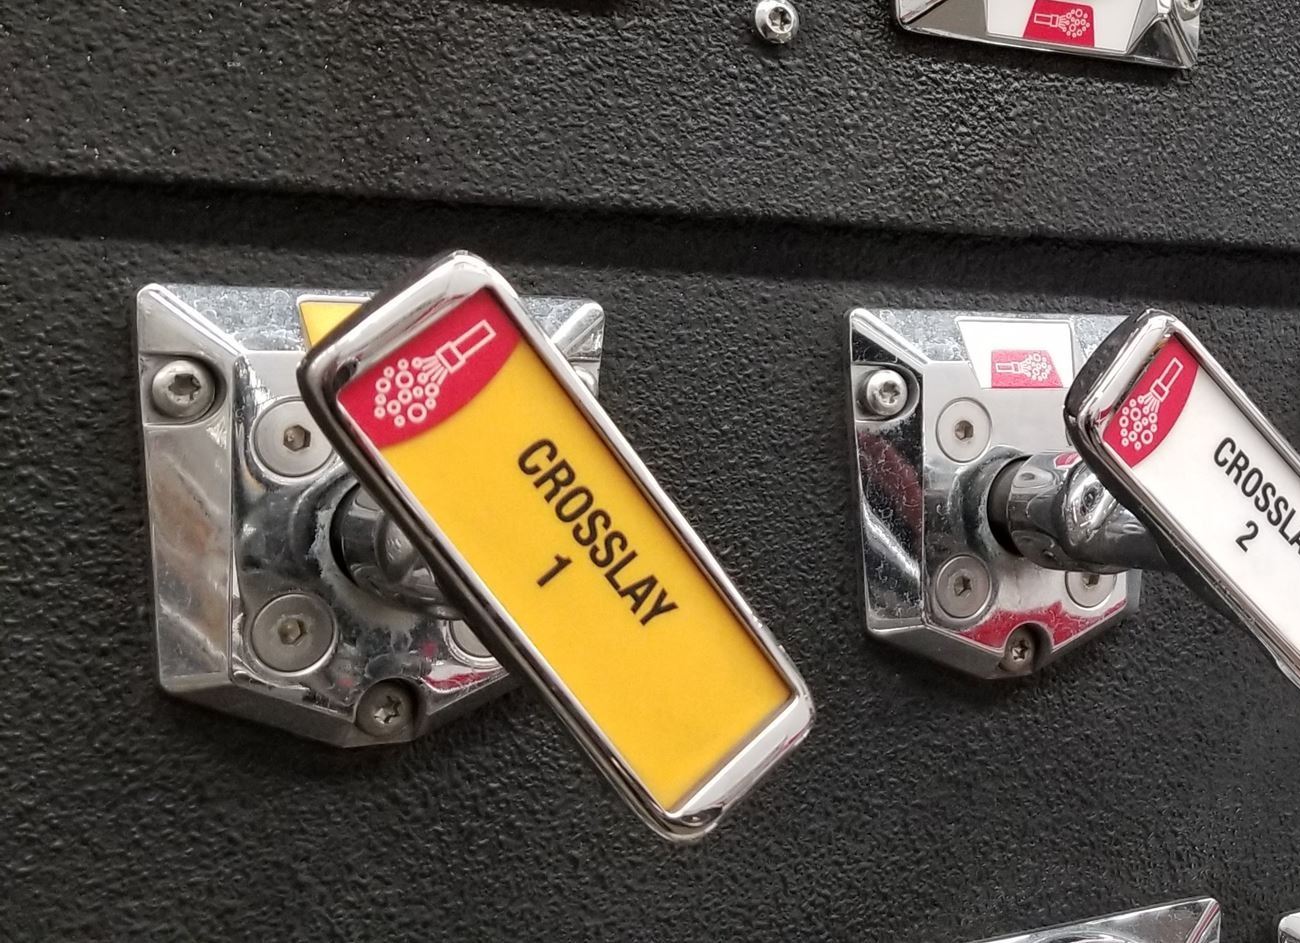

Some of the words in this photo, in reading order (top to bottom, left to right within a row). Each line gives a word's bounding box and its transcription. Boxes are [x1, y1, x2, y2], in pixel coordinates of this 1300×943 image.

[517, 438, 679, 627] CROSSLAY
[1235, 520, 1259, 553] 2
[536, 553, 573, 588] 1
